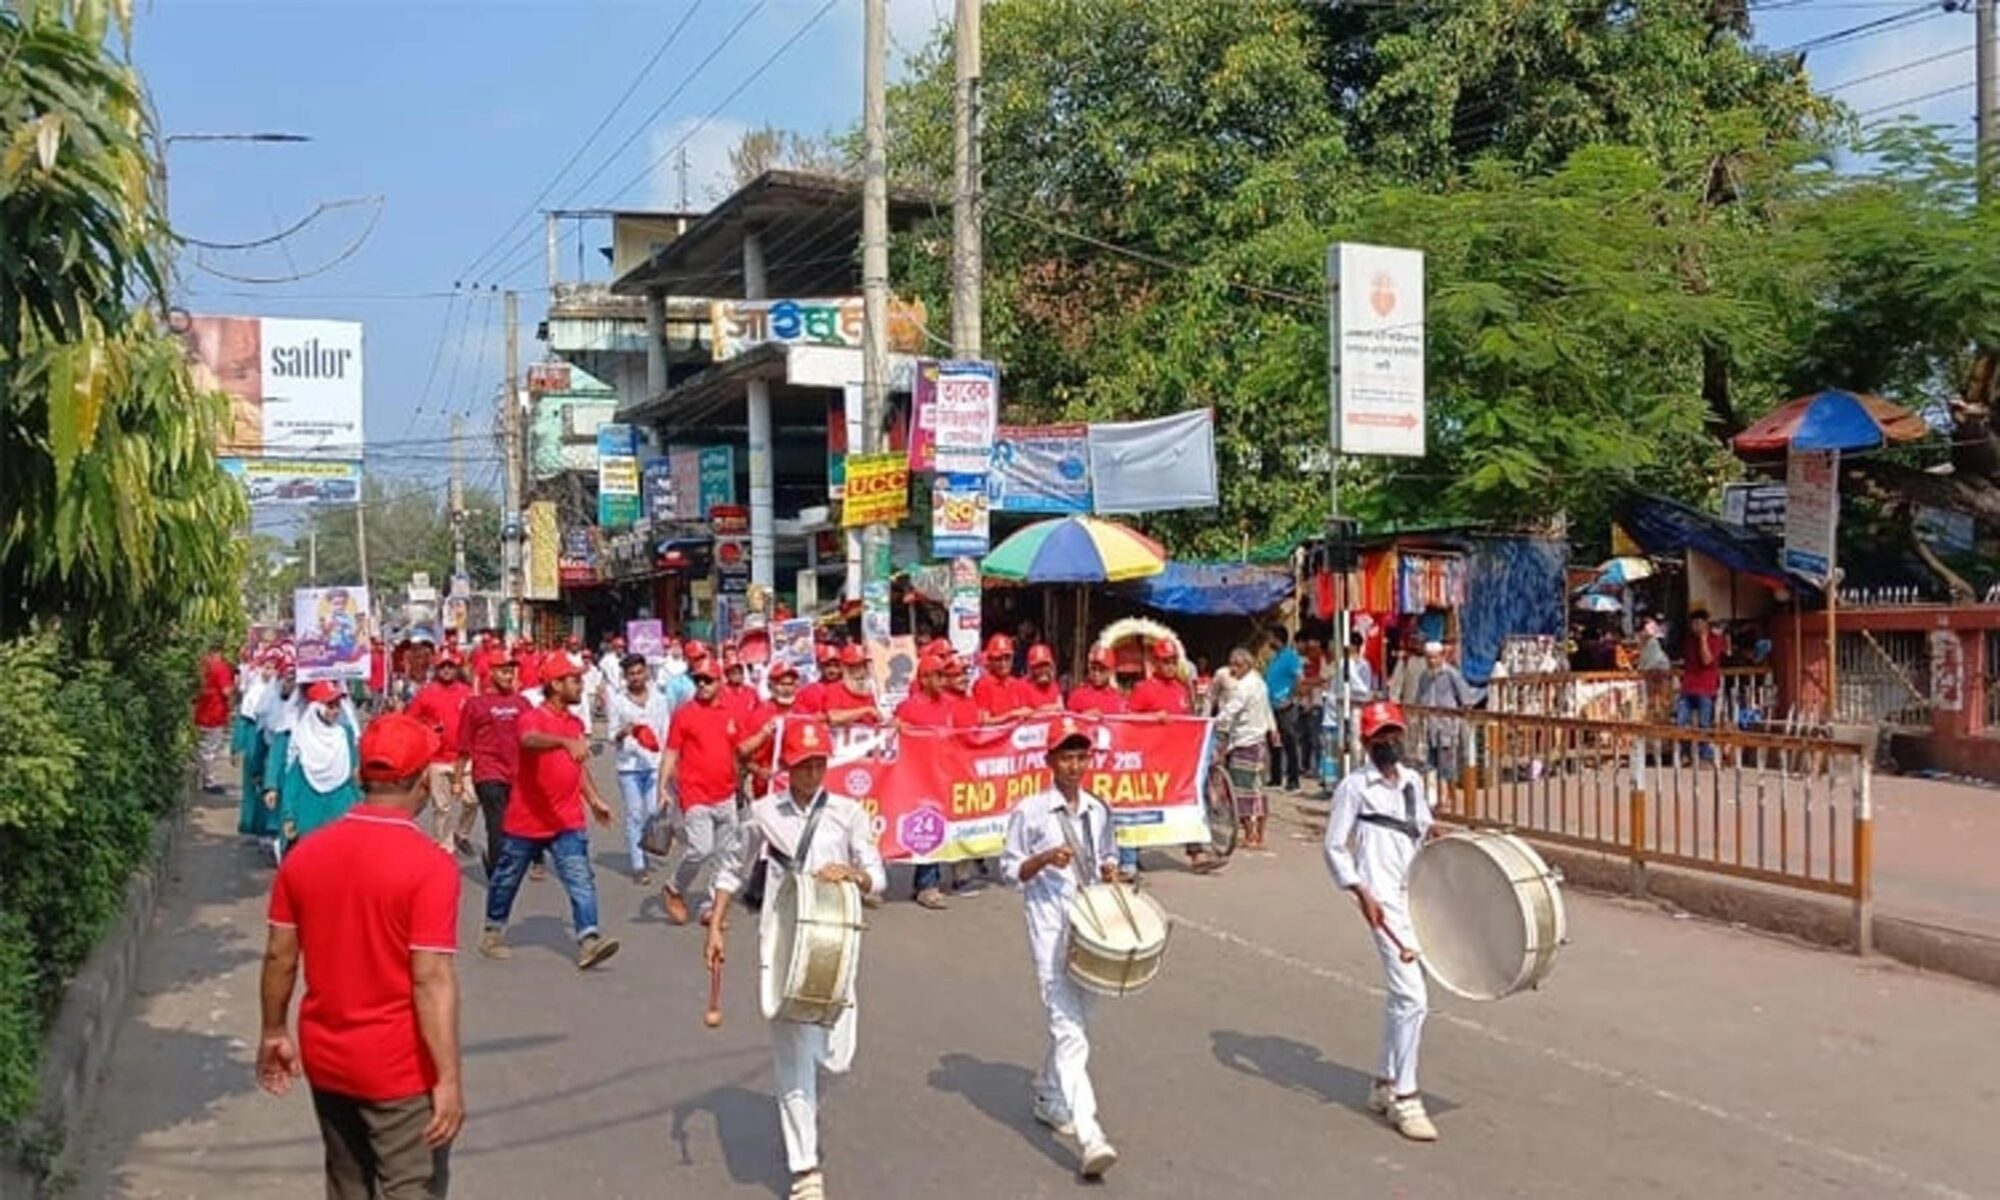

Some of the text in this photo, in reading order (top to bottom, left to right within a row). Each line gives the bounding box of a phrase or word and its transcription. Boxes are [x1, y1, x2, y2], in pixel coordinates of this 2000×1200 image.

[271, 337, 352, 379] sailor
[849, 471, 907, 494] UCC
[952, 781, 996, 815] END
[1092, 771, 1171, 803] RALLY
[913, 814, 934, 834] 24
